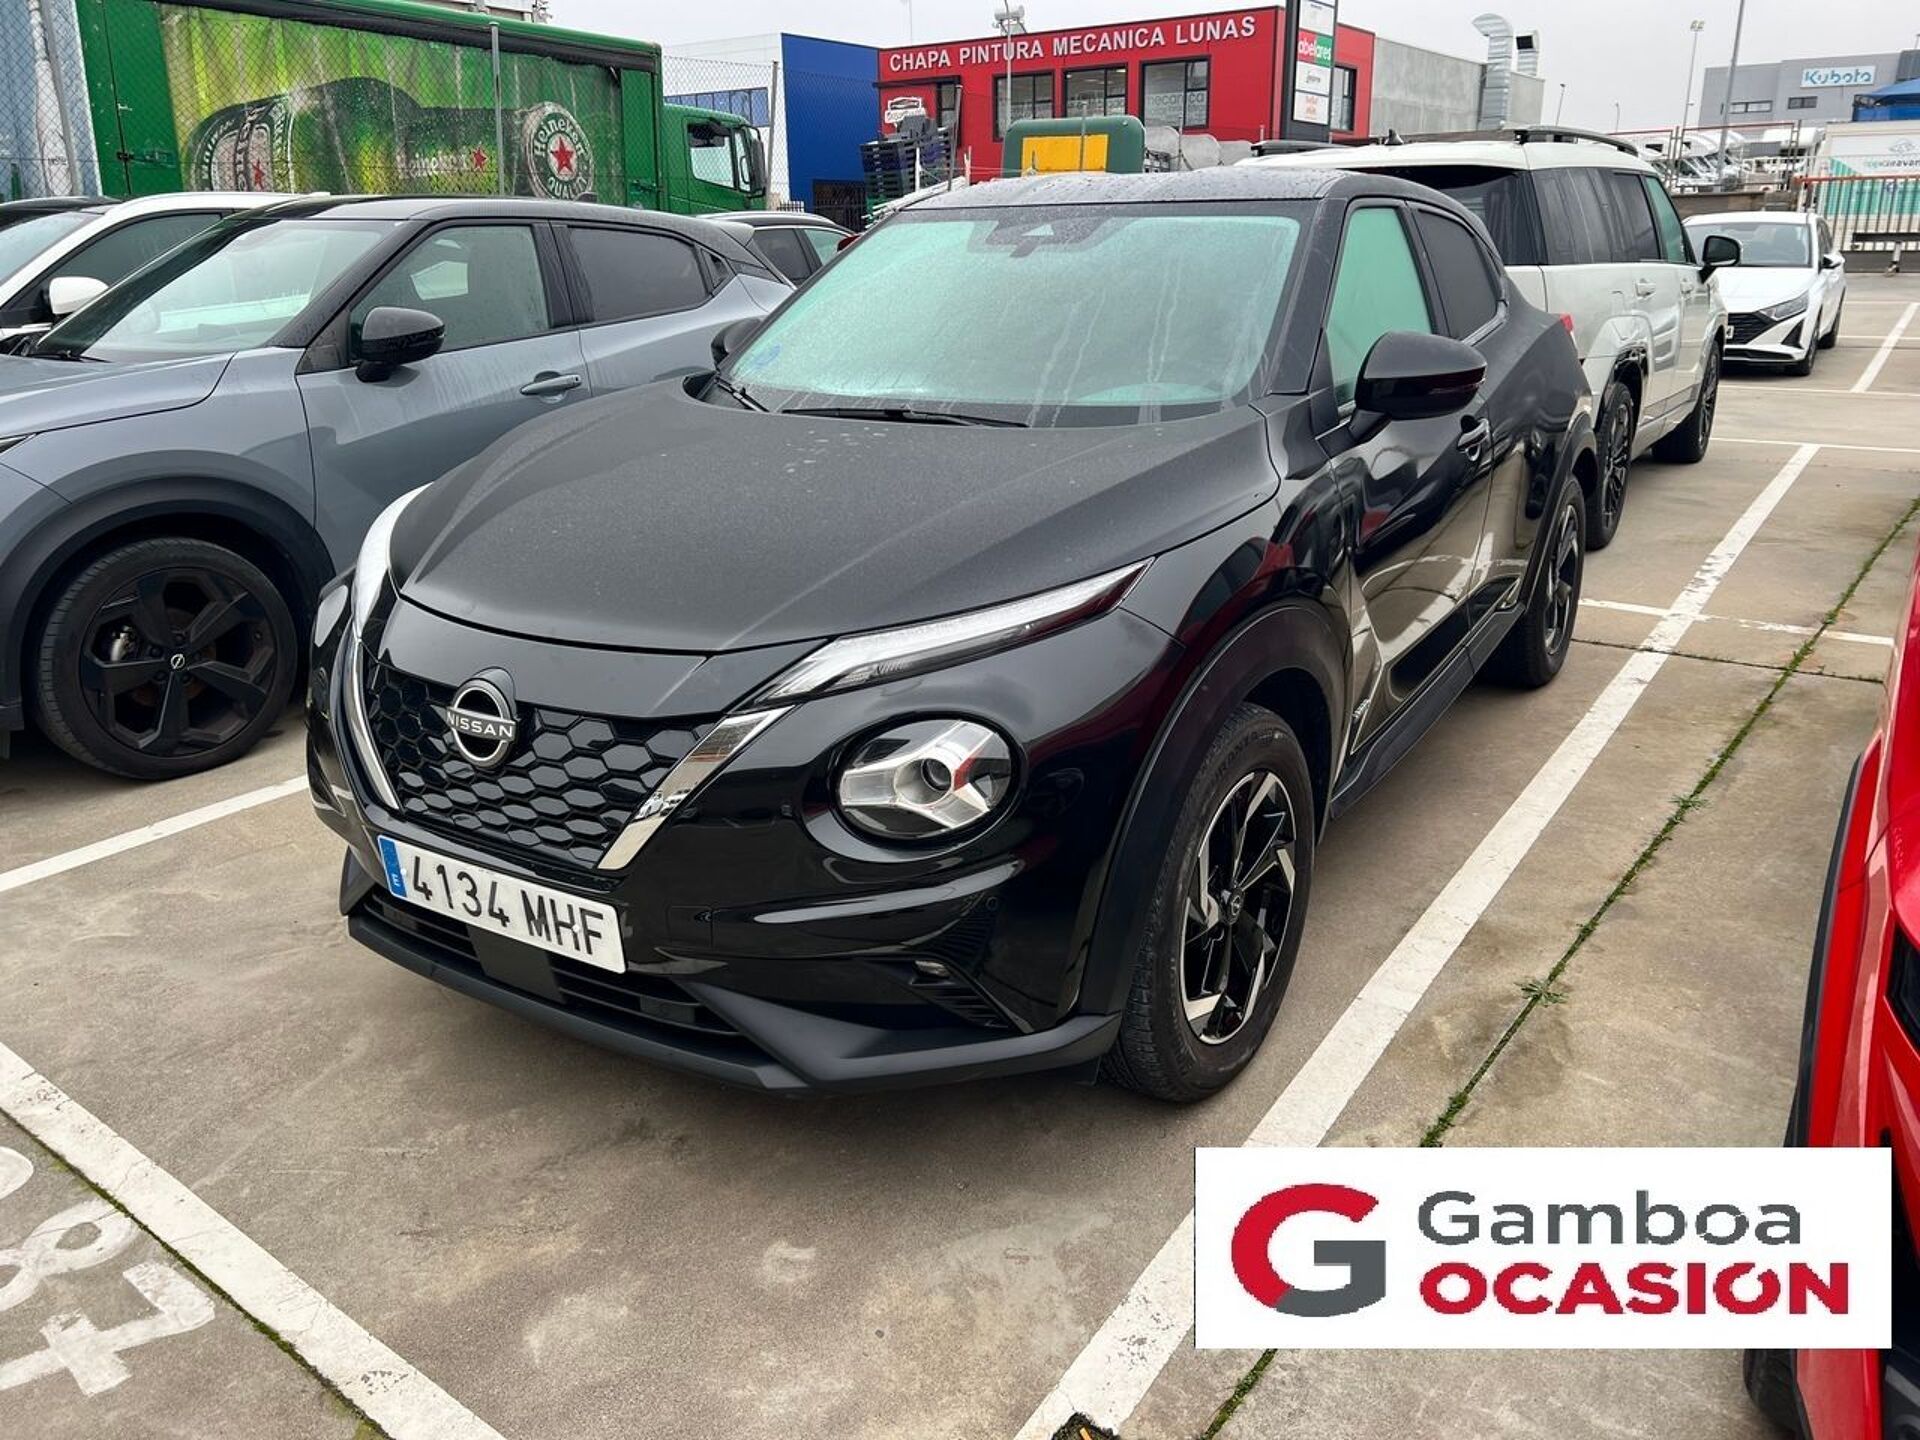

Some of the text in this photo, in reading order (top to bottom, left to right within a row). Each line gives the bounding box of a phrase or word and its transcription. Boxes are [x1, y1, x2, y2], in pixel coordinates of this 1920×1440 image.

[890, 15, 1256, 72] CHAPA PINTURA MECANICA LUNAS
[1805, 68, 1872, 84] Kubota
[534, 119, 588, 158] Heineken
[447, 713, 513, 738] NISSAN
[391, 873, 401, 887] E
[412, 856, 604, 955] 4134 MHF
